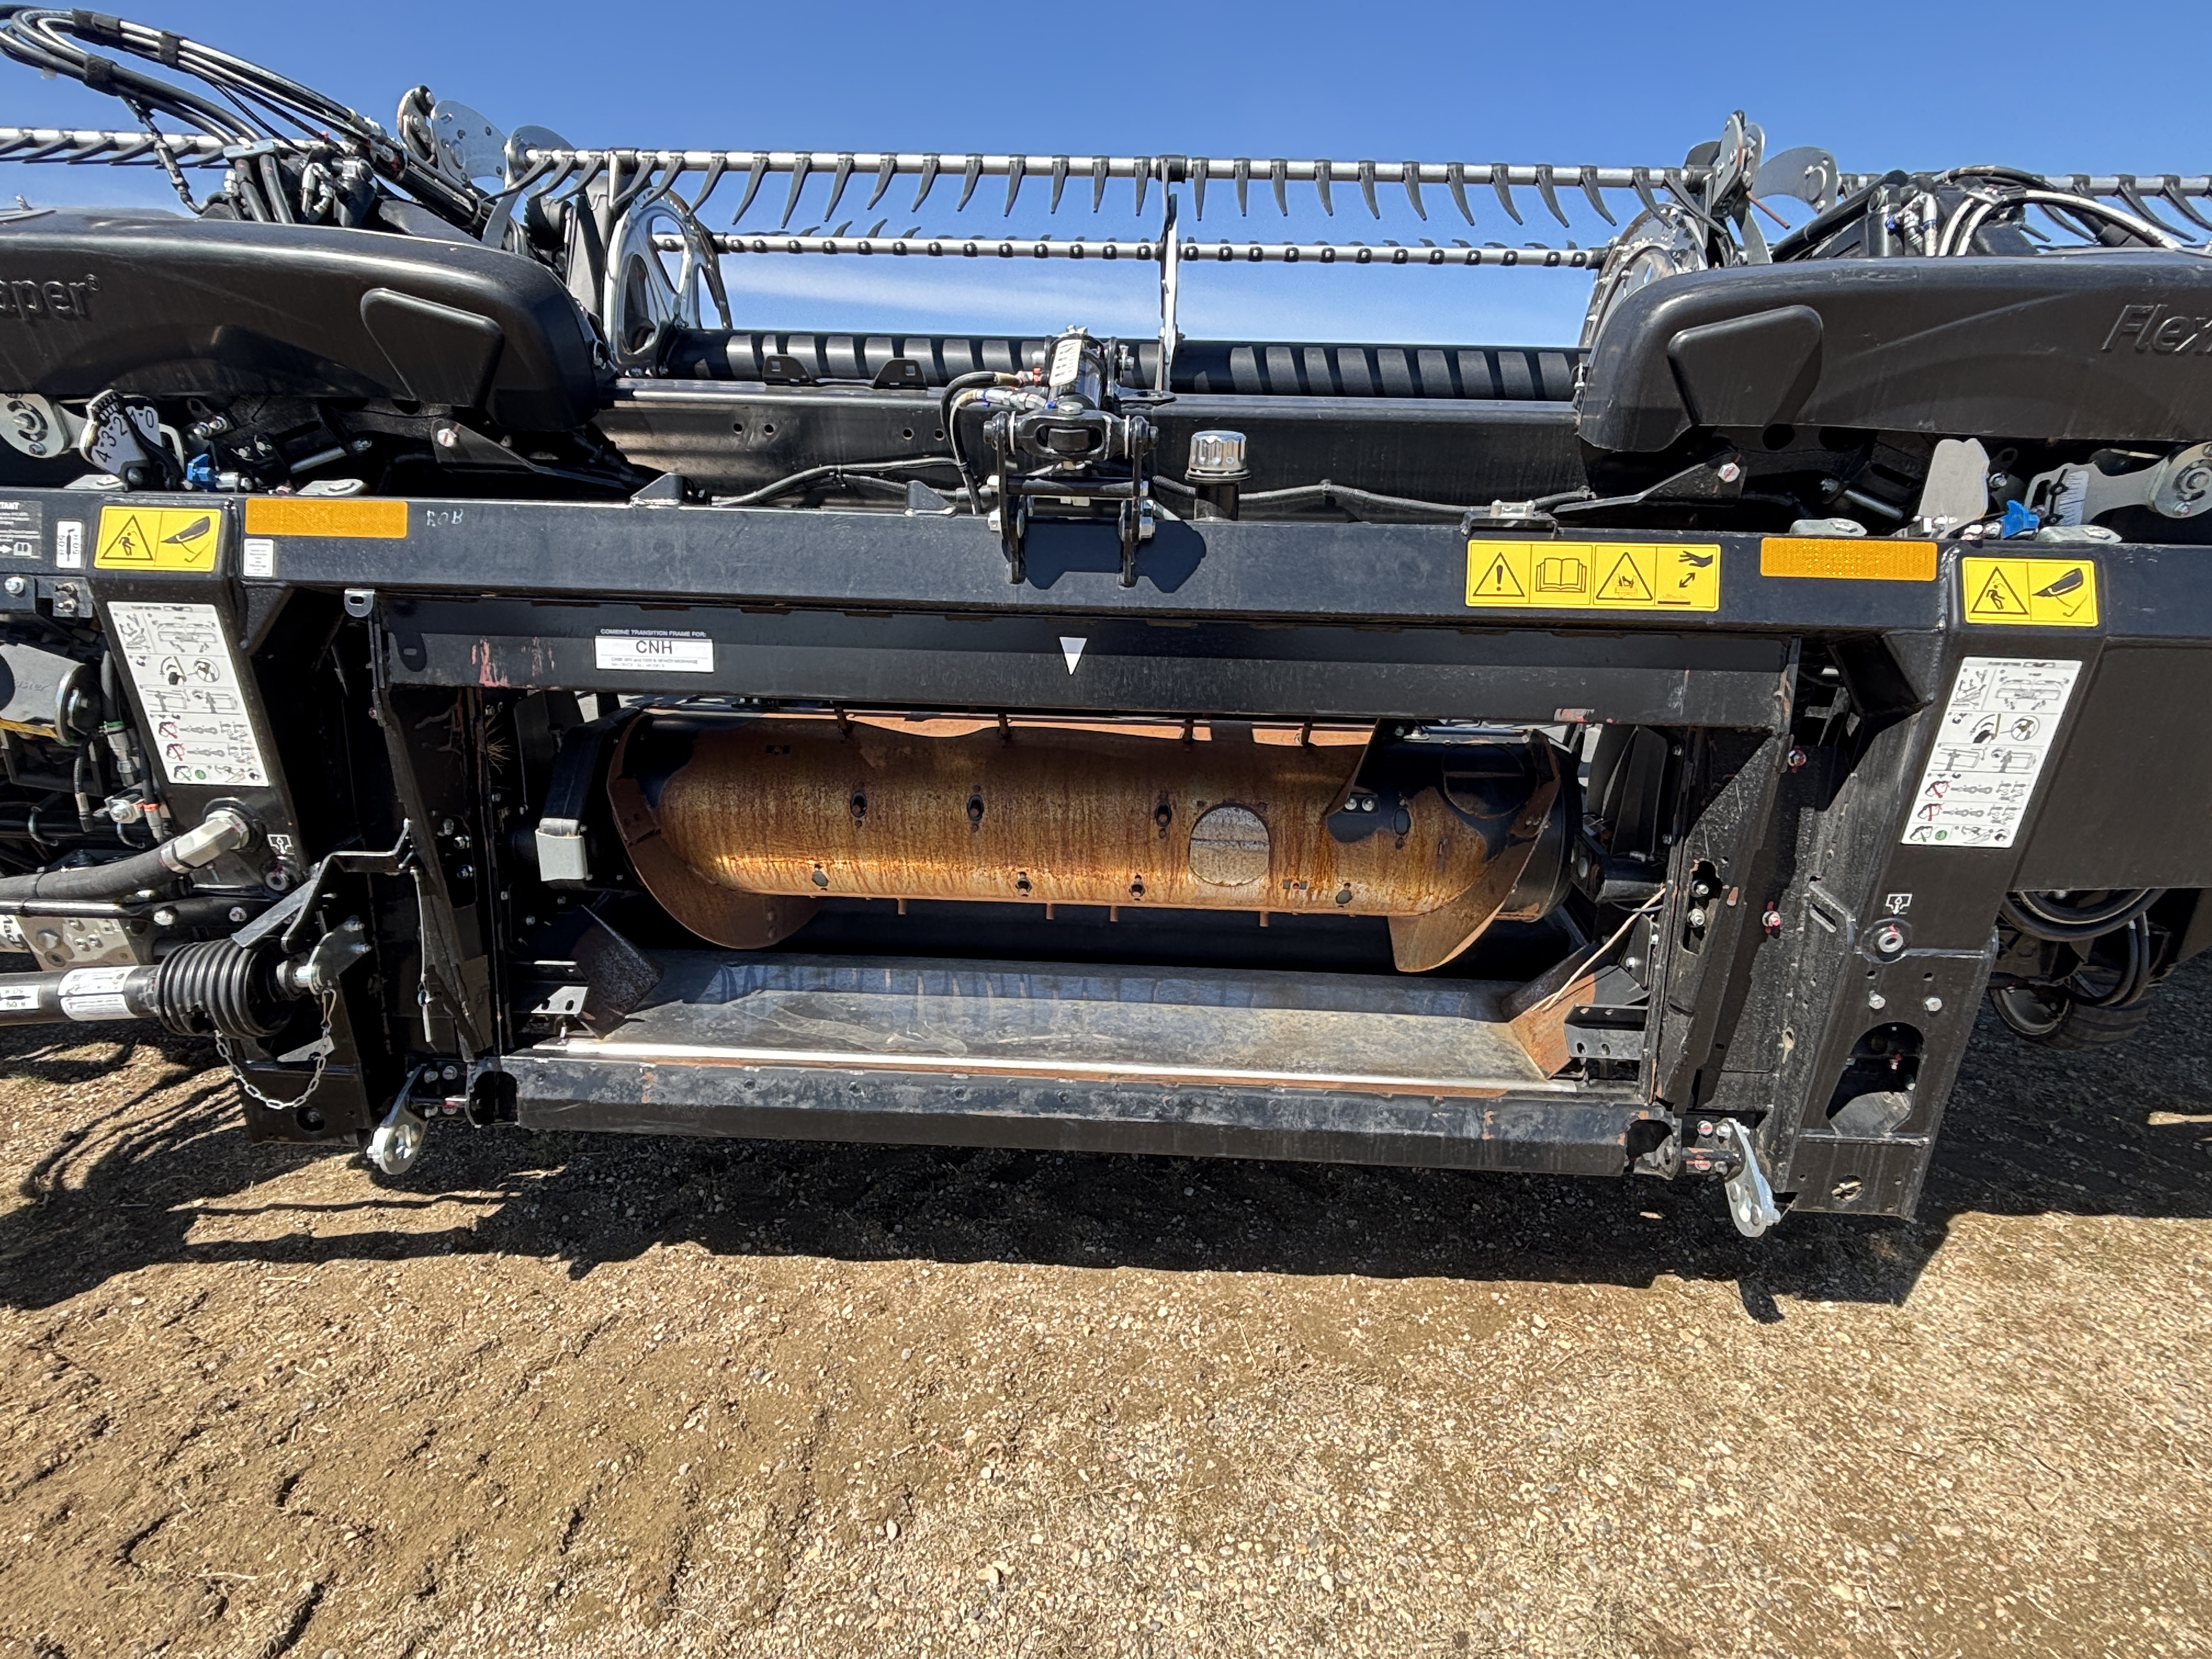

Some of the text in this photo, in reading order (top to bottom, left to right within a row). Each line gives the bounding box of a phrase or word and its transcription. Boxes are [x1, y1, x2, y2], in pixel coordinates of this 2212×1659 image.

[2101, 303, 2212, 356] Flex
[113, 416, 128, 437] 2
[145, 409, 155, 428] 0
[101, 430, 116, 447] 3
[95, 449, 112, 463] 4
[636, 640, 673, 654] CNH
